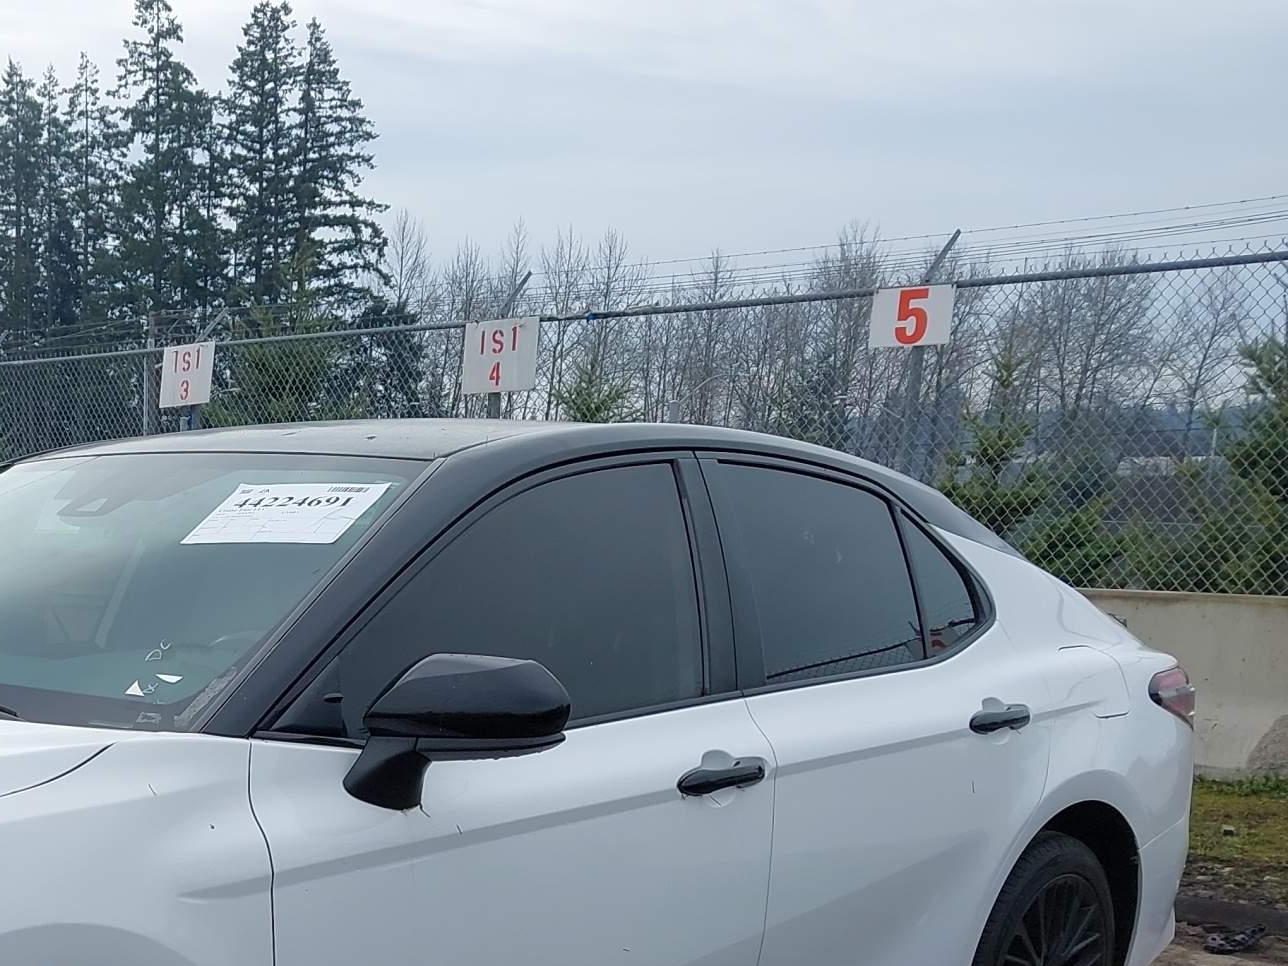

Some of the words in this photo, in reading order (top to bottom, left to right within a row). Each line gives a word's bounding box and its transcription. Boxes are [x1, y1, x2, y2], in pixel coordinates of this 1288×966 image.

[894, 287, 930, 345] 5
[489, 361, 500, 386] 4
[180, 379, 190, 401] 3
[233, 496, 354, 509] 44224691
